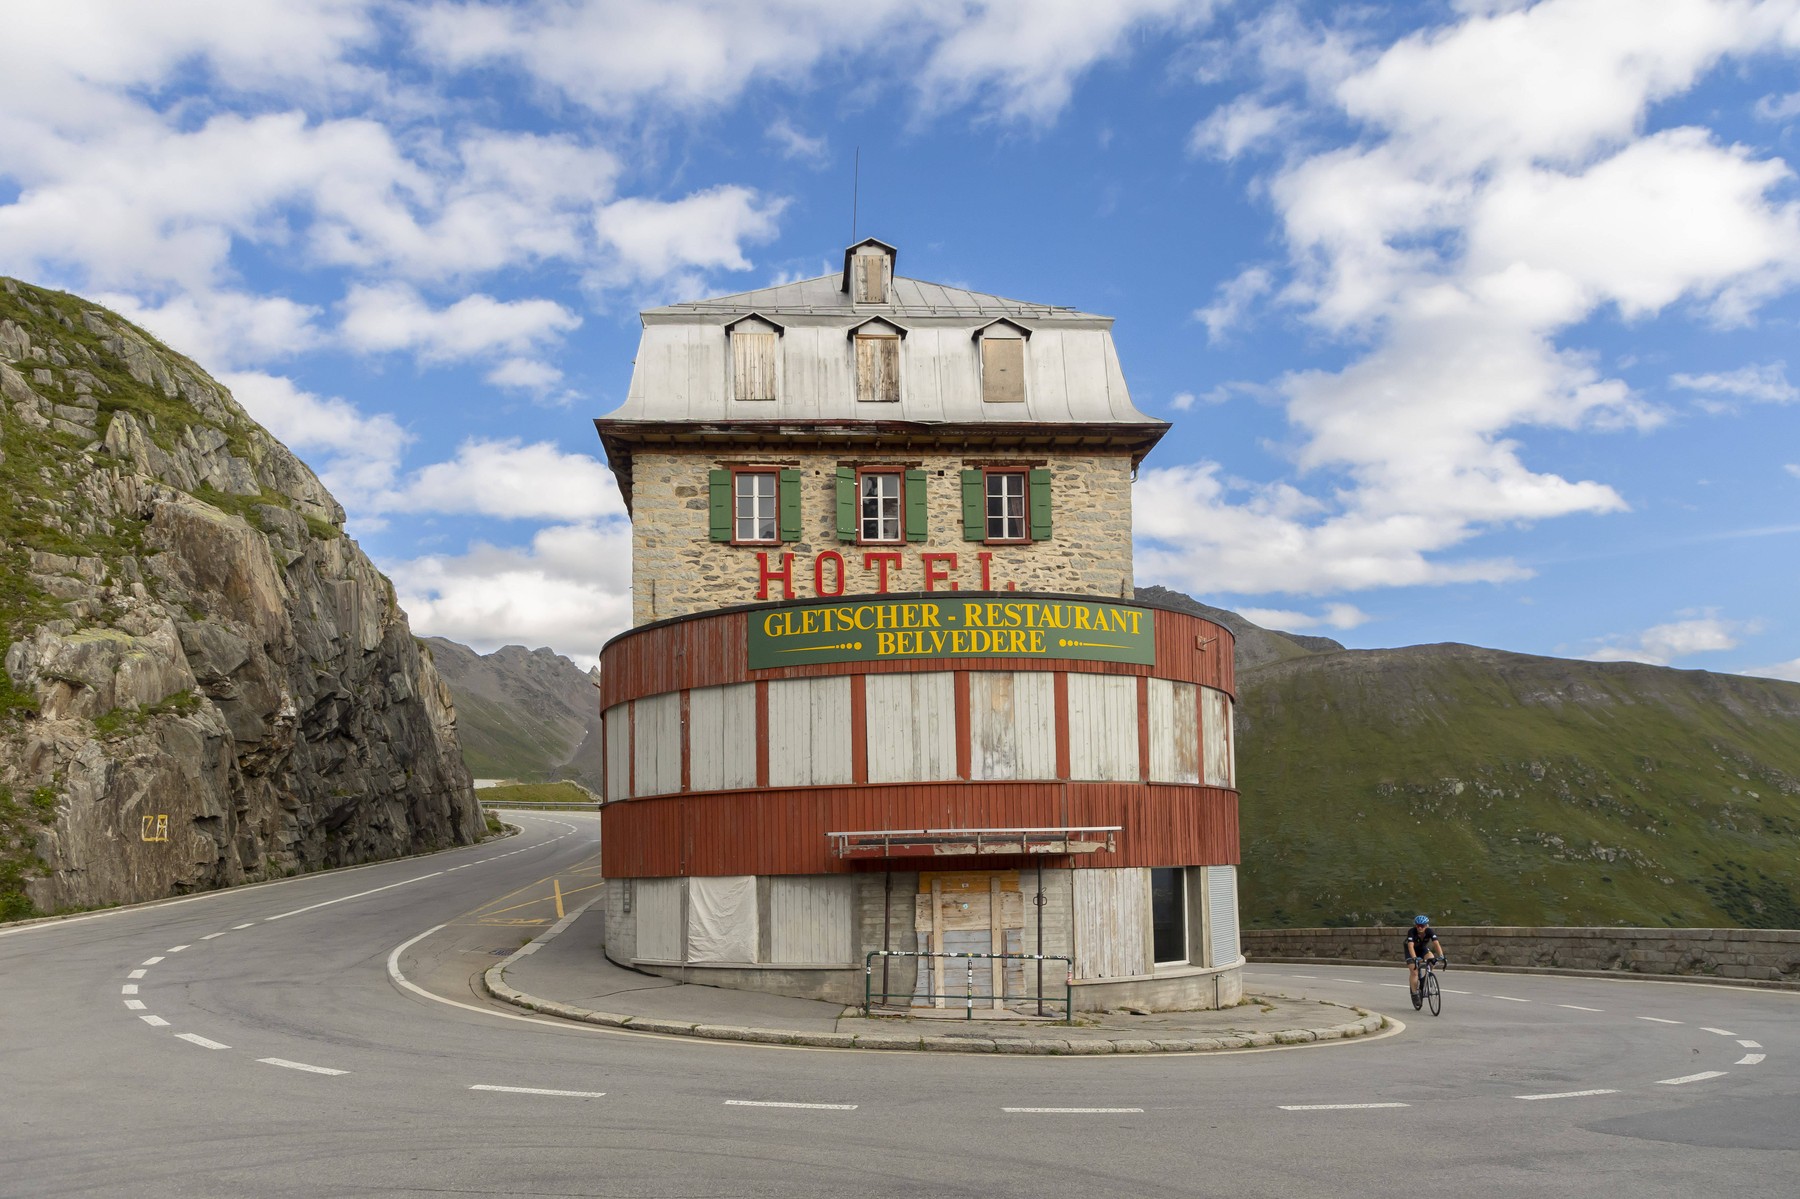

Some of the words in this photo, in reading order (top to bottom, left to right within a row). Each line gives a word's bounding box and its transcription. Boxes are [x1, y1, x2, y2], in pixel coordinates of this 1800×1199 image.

[756, 550, 1016, 600] HOTEL
[763, 603, 941, 637] GLETSCHER
[963, 602, 1143, 635] RESTAURANT
[876, 629, 1047, 655] BELVEDERE
